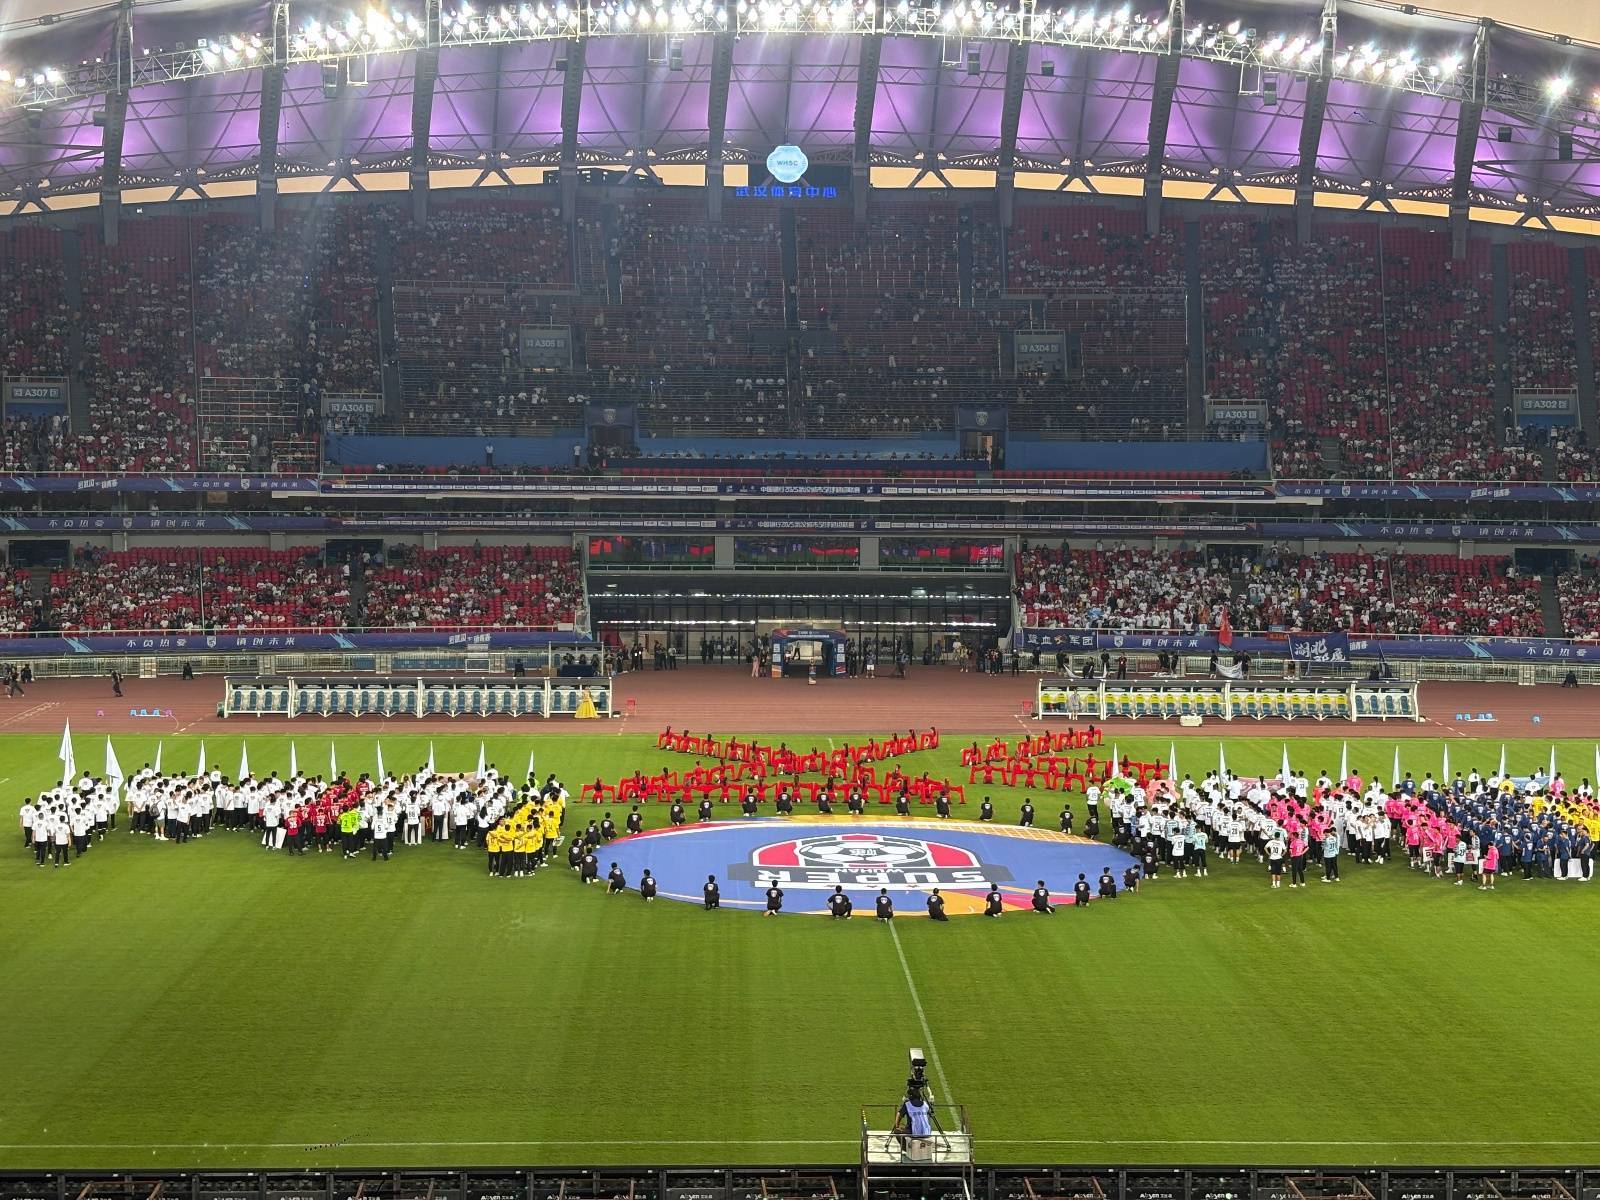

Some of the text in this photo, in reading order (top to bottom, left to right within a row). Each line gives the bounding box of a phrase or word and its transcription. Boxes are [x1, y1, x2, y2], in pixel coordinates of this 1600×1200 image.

[736, 186, 837, 198] 武汉体育中心
[25, 388, 48, 397] A307
[342, 404, 364, 412] A306
[1534, 400, 1557, 409] A302
[1225, 410, 1248, 419] A303
[127, 638, 188, 648] 不负热爱
[1526, 646, 1588, 657] 不负热爱
[758, 870, 986, 883] SUPER
